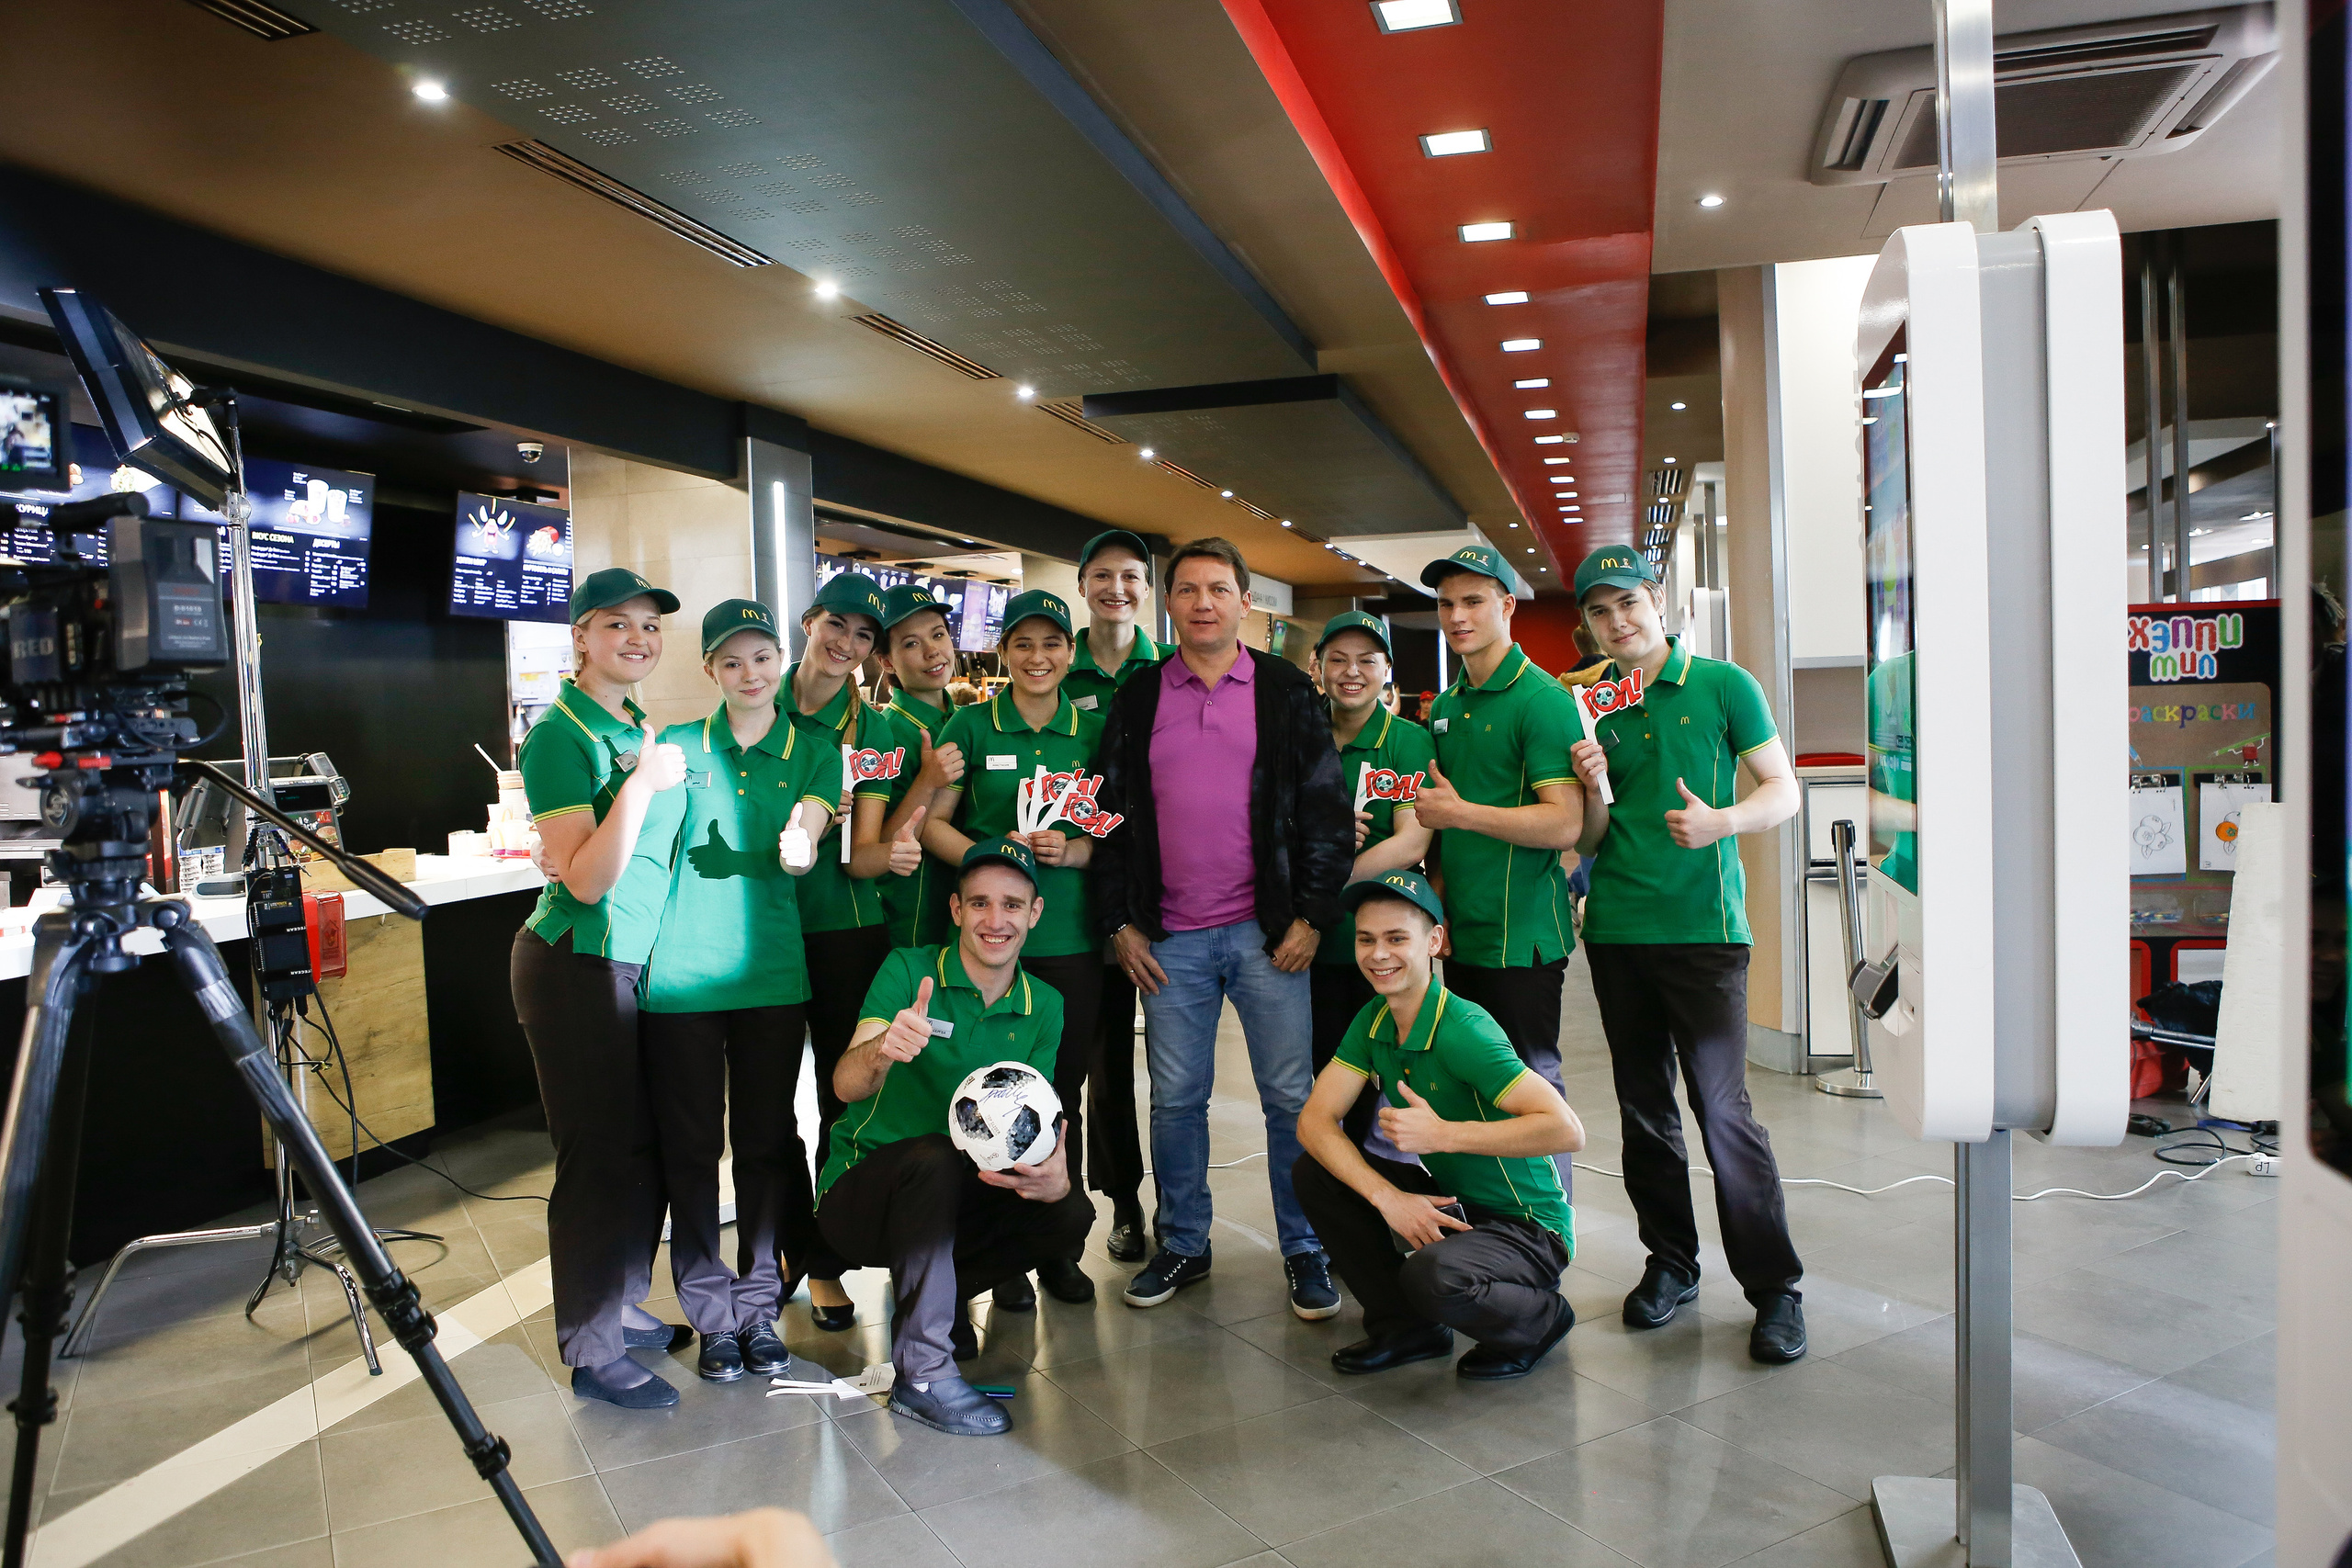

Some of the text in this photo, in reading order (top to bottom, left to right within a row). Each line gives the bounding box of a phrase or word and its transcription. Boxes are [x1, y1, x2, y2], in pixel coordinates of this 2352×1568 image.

[269, 533, 294, 544] СЕЗОНА
[12, 638, 54, 660] RED
[1582, 670, 1642, 719] ГОЛ!
[849, 749, 904, 781] ГОЛ!
[1365, 770, 1424, 800] ГОЛ!
[1060, 793, 1123, 836] ГОЛ!
